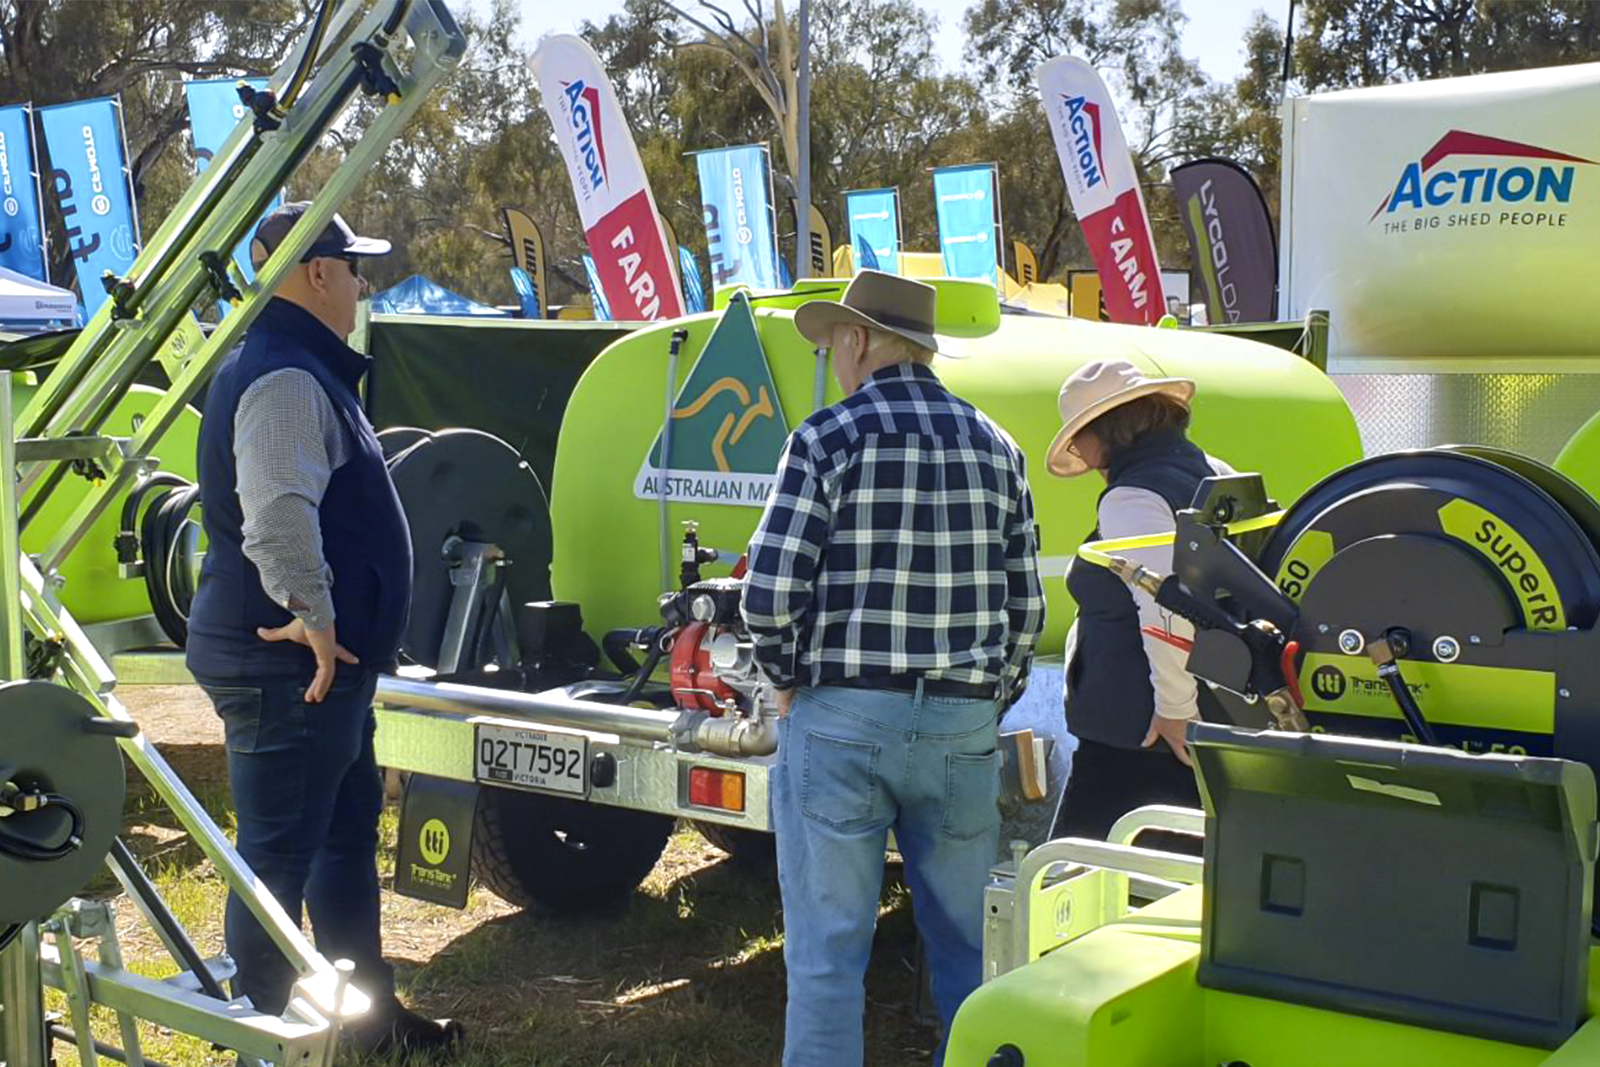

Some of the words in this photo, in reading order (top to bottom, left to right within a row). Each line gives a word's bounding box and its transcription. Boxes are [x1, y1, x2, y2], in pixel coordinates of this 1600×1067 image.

[564, 80, 603, 190] ACTION
[1065, 96, 1101, 190] ACTION
[1386, 162, 1576, 214] ACTION
[1384, 220, 1408, 235] THE
[1414, 216, 1440, 231] BIG
[1448, 213, 1491, 228] SHED
[1499, 212, 1568, 228] PEOPLE
[642, 477, 743, 500] AUSTRALIAN
[1279, 560, 1310, 598] 50
[1474, 519, 1557, 630] SuperR
[480, 737, 581, 780] 02T7592
[513, 773, 547, 786] VICTORIA
